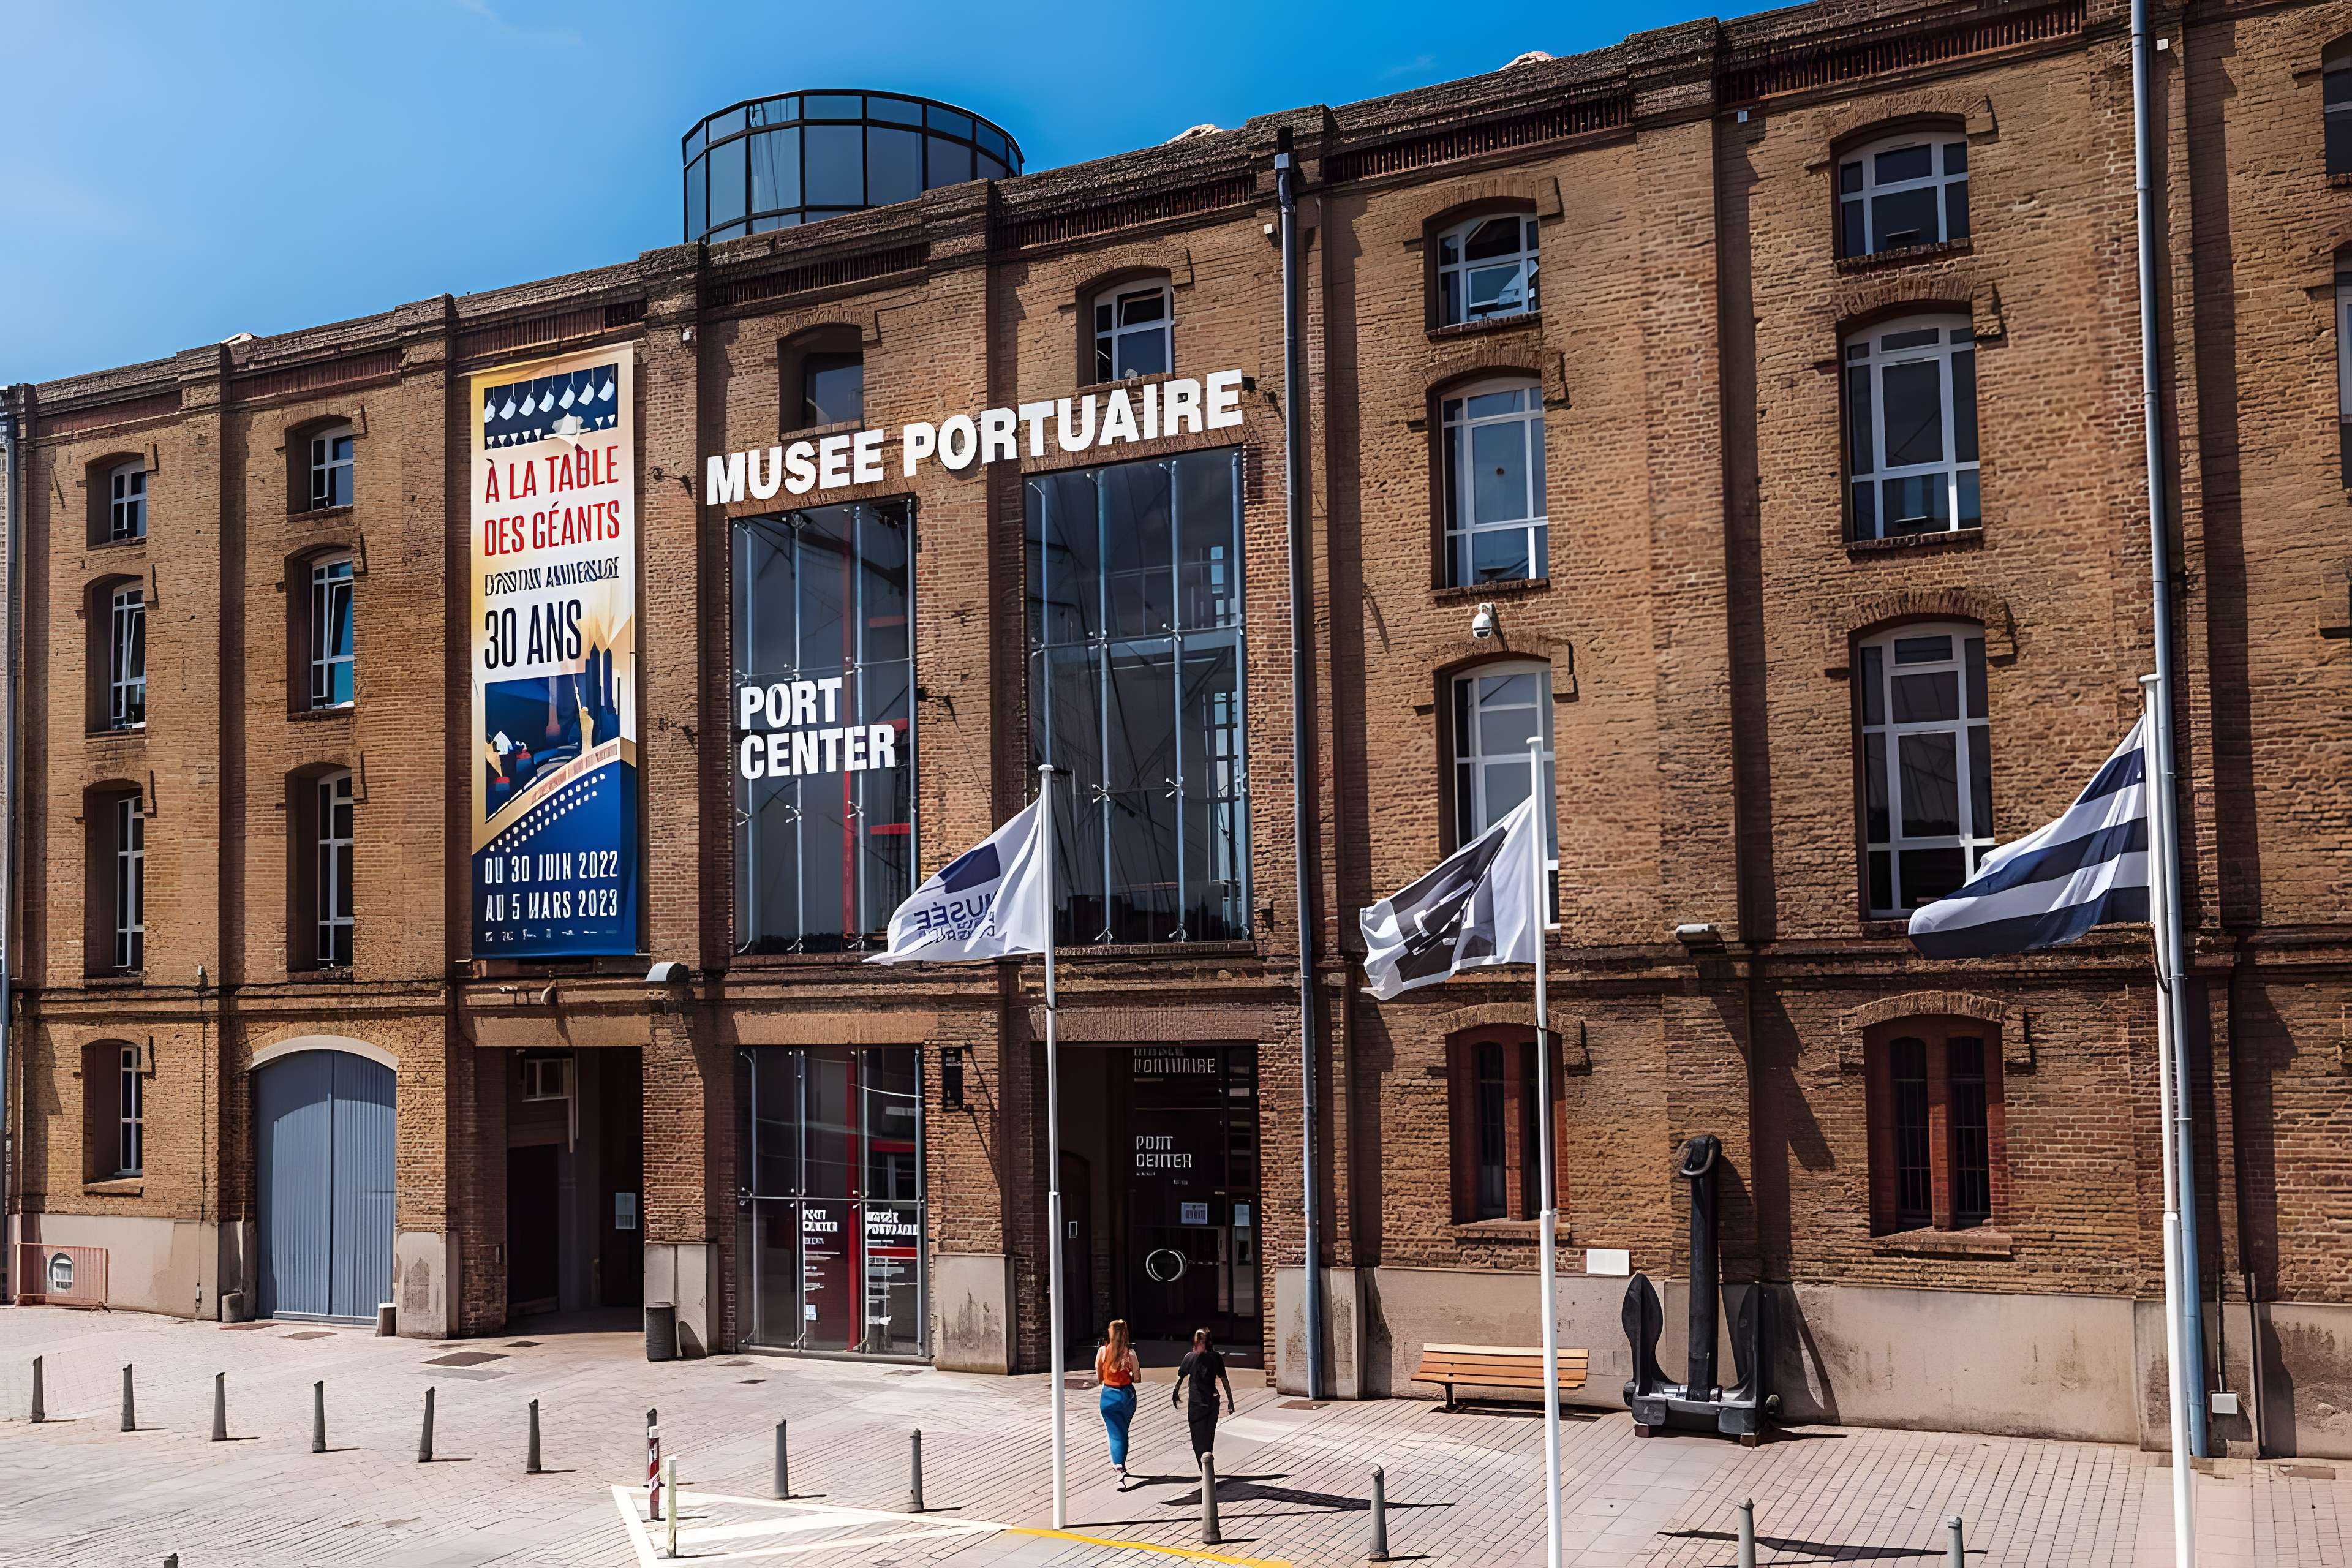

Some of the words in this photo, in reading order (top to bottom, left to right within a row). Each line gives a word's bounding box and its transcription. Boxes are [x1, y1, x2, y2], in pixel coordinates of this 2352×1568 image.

[707, 429, 884, 505] MUSEE
[903, 369, 1243, 477] PORTUAIRE
[485, 458, 500, 503] À
[509, 461, 537, 500] LA
[545, 445, 619, 494] TABLE
[484, 515, 525, 556] DES
[533, 500, 620, 549] GÉANTS
[484, 607, 517, 669] 30
[527, 598, 581, 665] ANS
[741, 677, 842, 731] PORT
[741, 723, 896, 780] CENTER
[484, 857, 503, 884] DU
[511, 855, 530, 883] 30
[538, 852, 571, 881] JUIN
[579, 850, 618, 879] 2022
[485, 894, 504, 922] AU
[512, 893, 521, 920] 5
[529, 891, 571, 919] MARS
[578, 889, 617, 917] 2023
